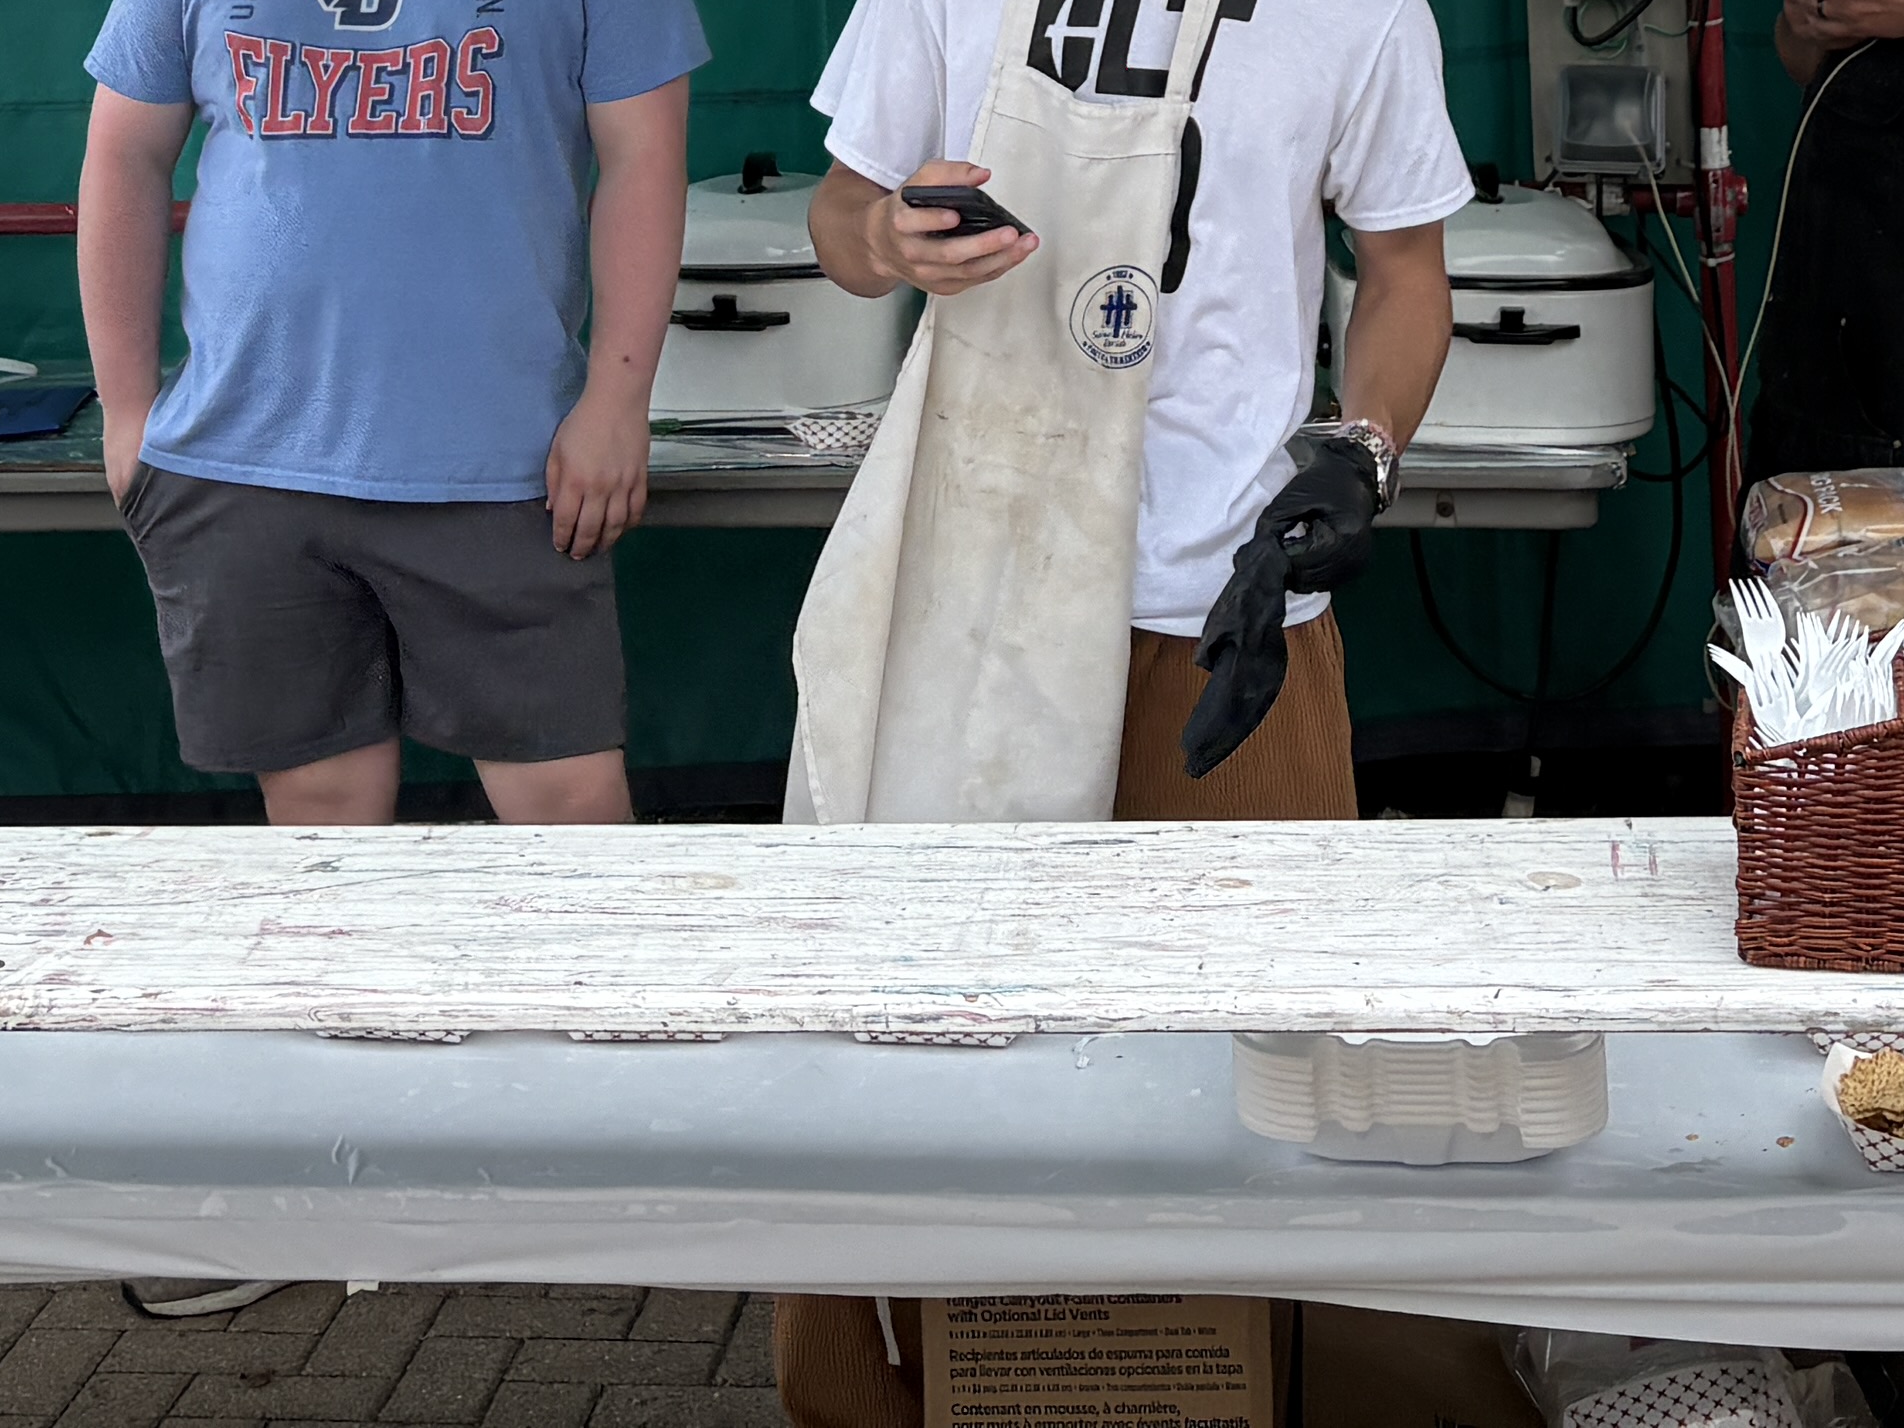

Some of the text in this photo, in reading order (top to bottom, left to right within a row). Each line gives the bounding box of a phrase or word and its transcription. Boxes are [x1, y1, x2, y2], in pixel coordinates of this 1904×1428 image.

[223, 25, 506, 141] FLYERS
[948, 1308, 1110, 1324] with Optional Lid Vents
